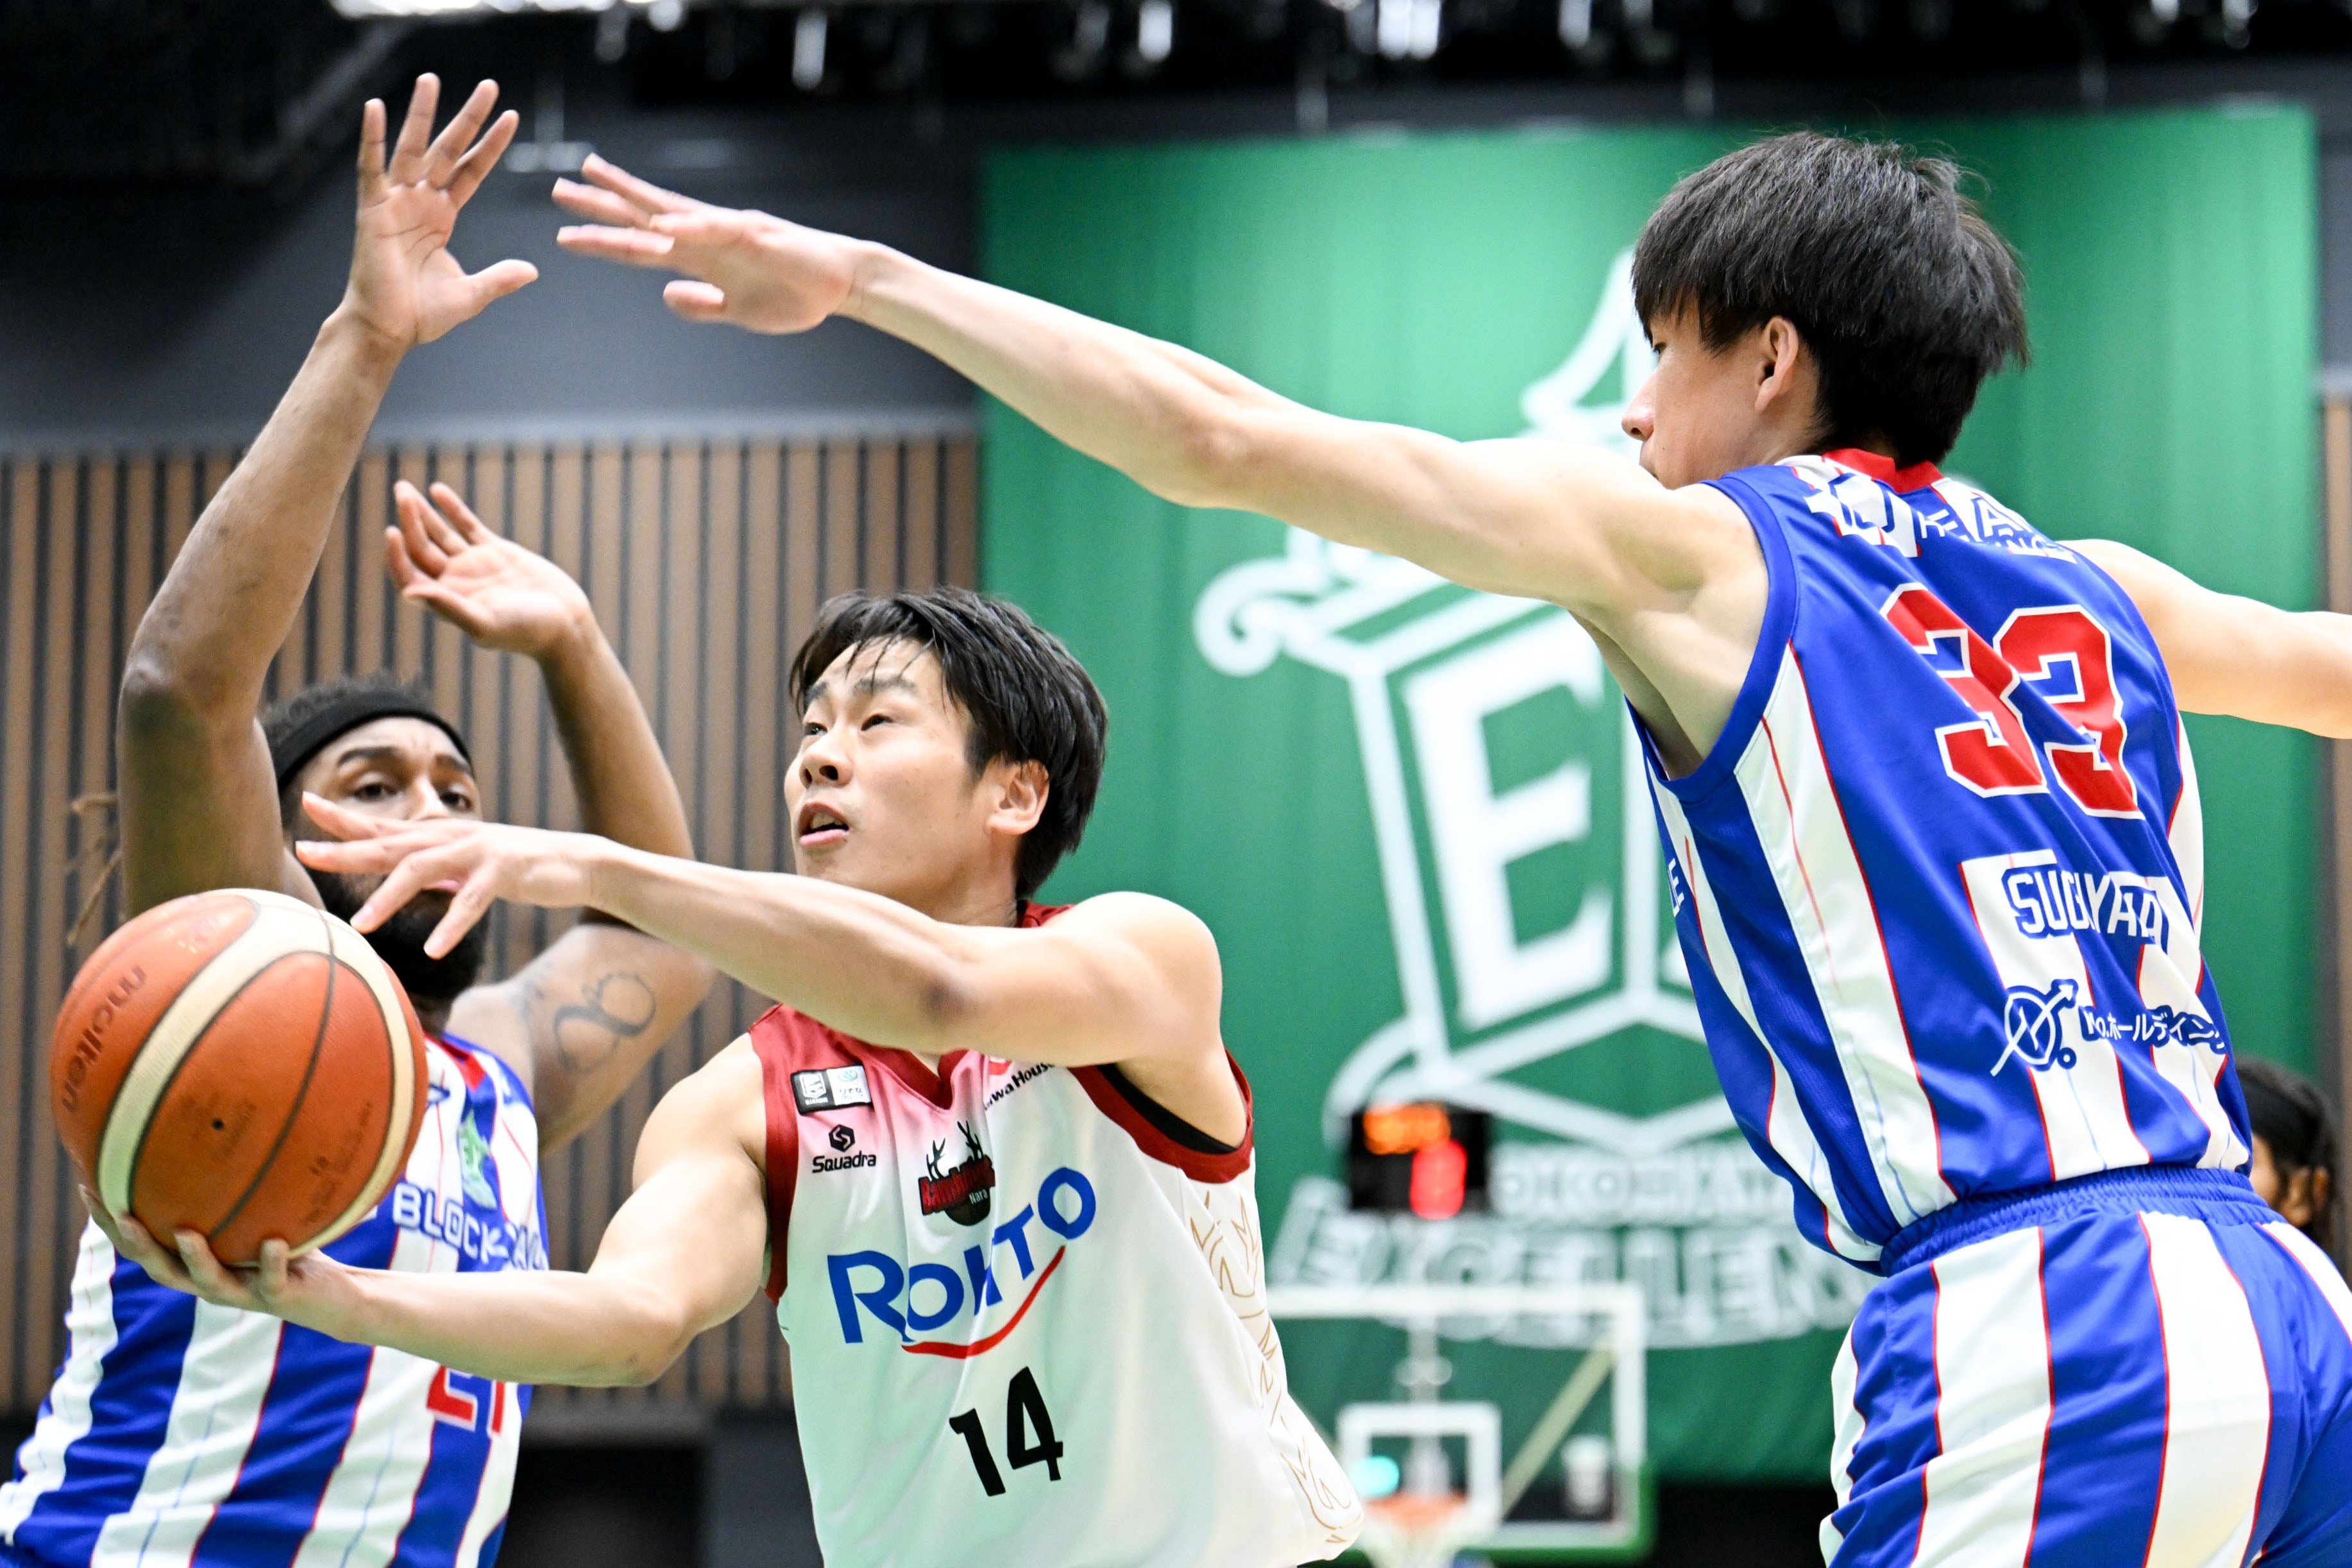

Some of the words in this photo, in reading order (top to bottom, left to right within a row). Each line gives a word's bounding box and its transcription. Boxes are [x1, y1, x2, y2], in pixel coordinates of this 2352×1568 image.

[1879, 582, 2145, 820] 33
[812, 1150, 877, 1174] Squadra
[969, 1188, 988, 1206] Nara
[949, 1365, 1064, 1497] 14
